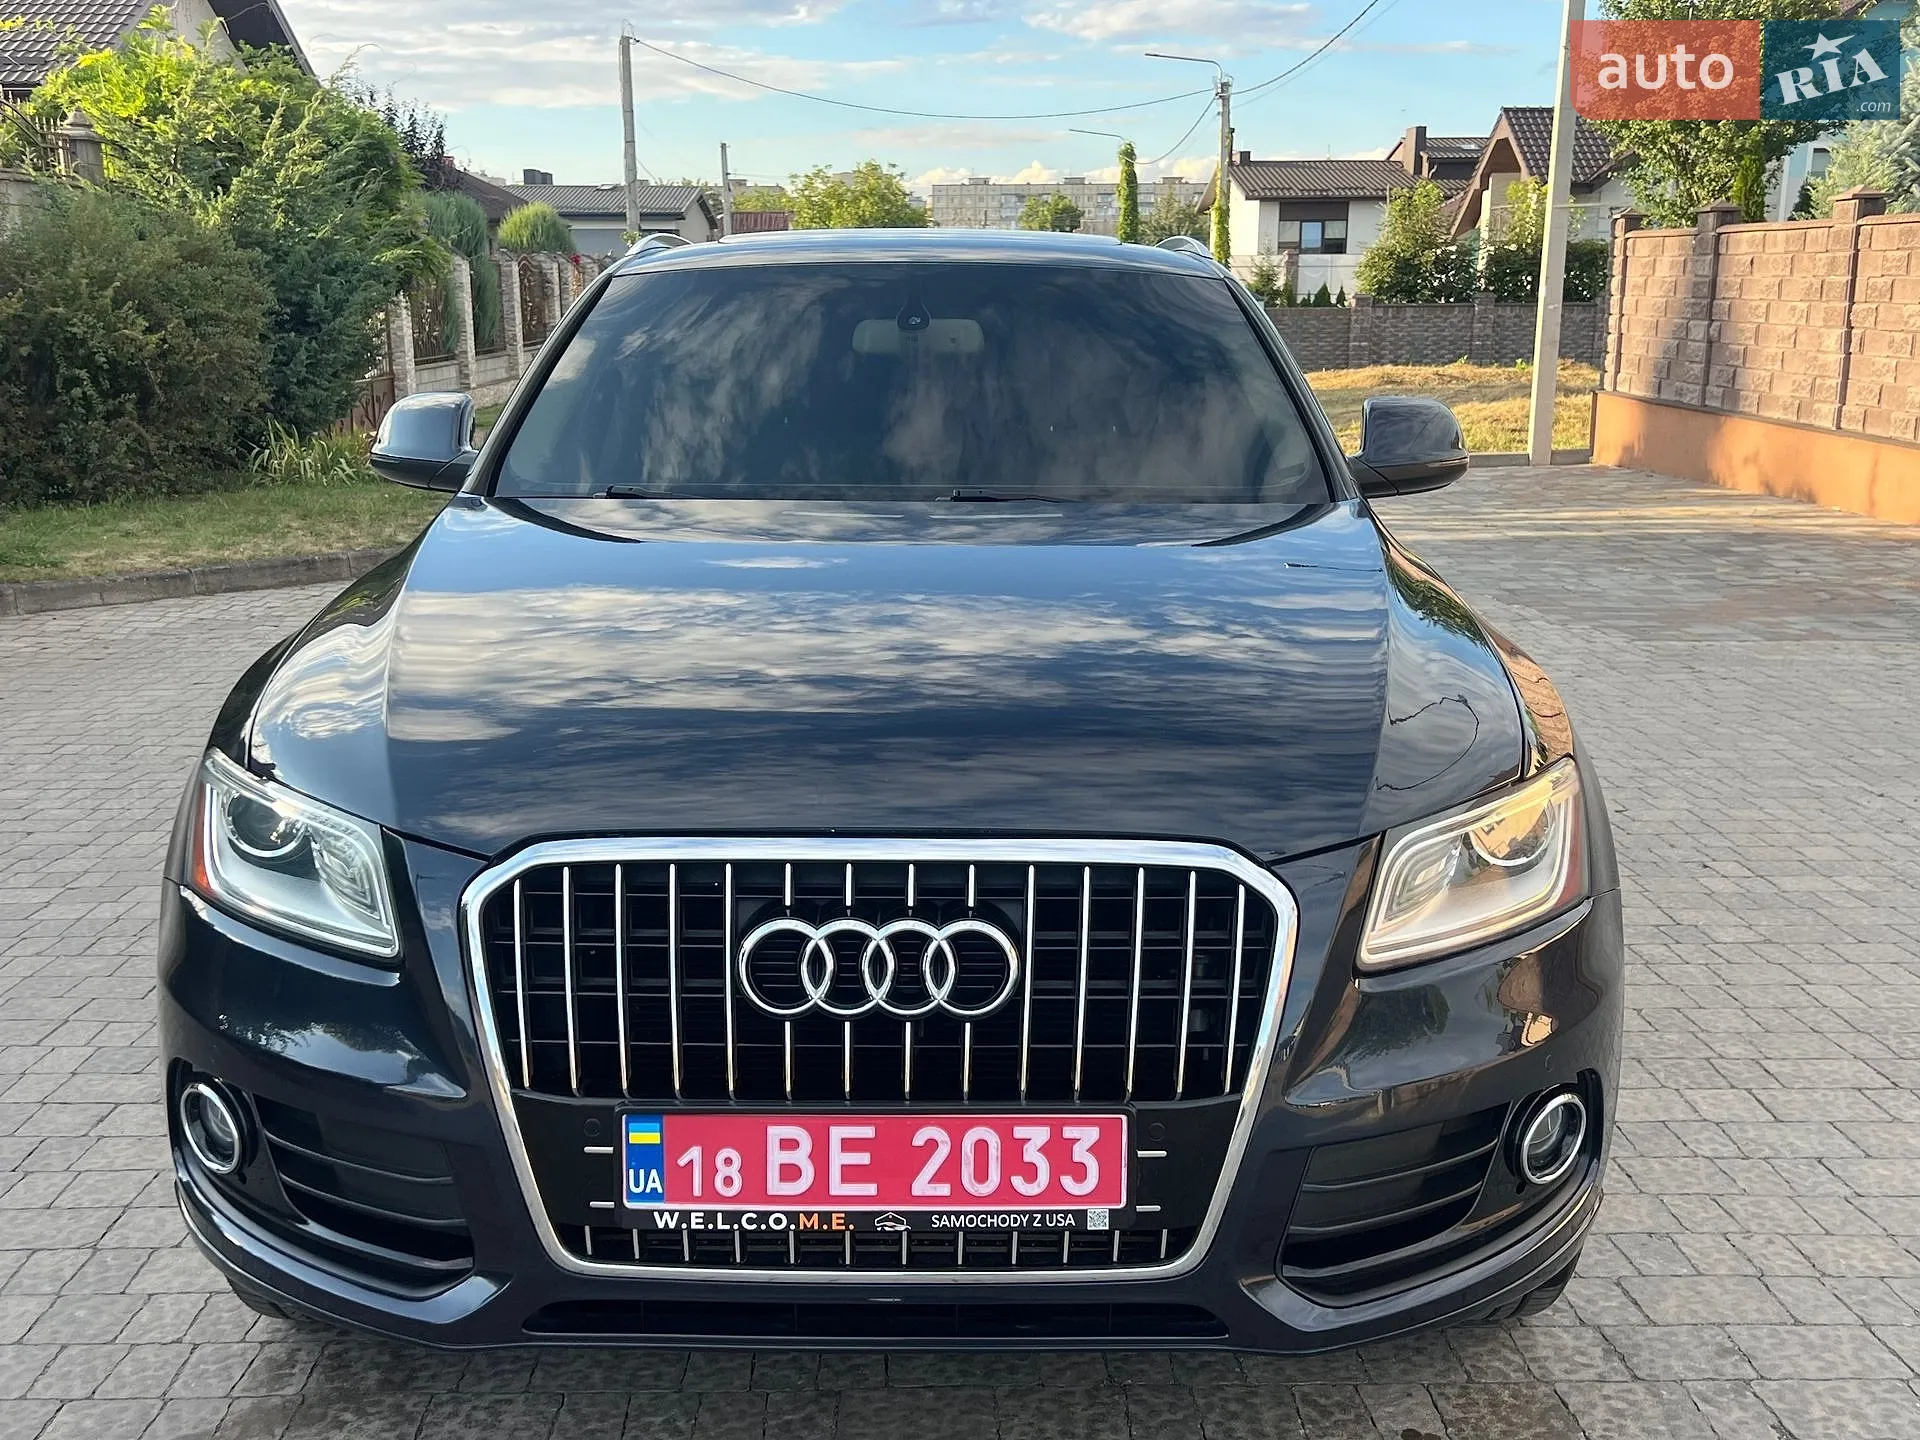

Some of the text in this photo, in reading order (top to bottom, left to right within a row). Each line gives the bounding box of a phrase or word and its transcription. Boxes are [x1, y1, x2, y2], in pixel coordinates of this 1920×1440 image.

[676, 1125, 1100, 1198] 18 BE 2033
[628, 1168, 663, 1194] UA
[653, 1211, 855, 1230] W.E.L.C.O.M.E.
[931, 1213, 1076, 1228] SAMOCHODY Z USA
